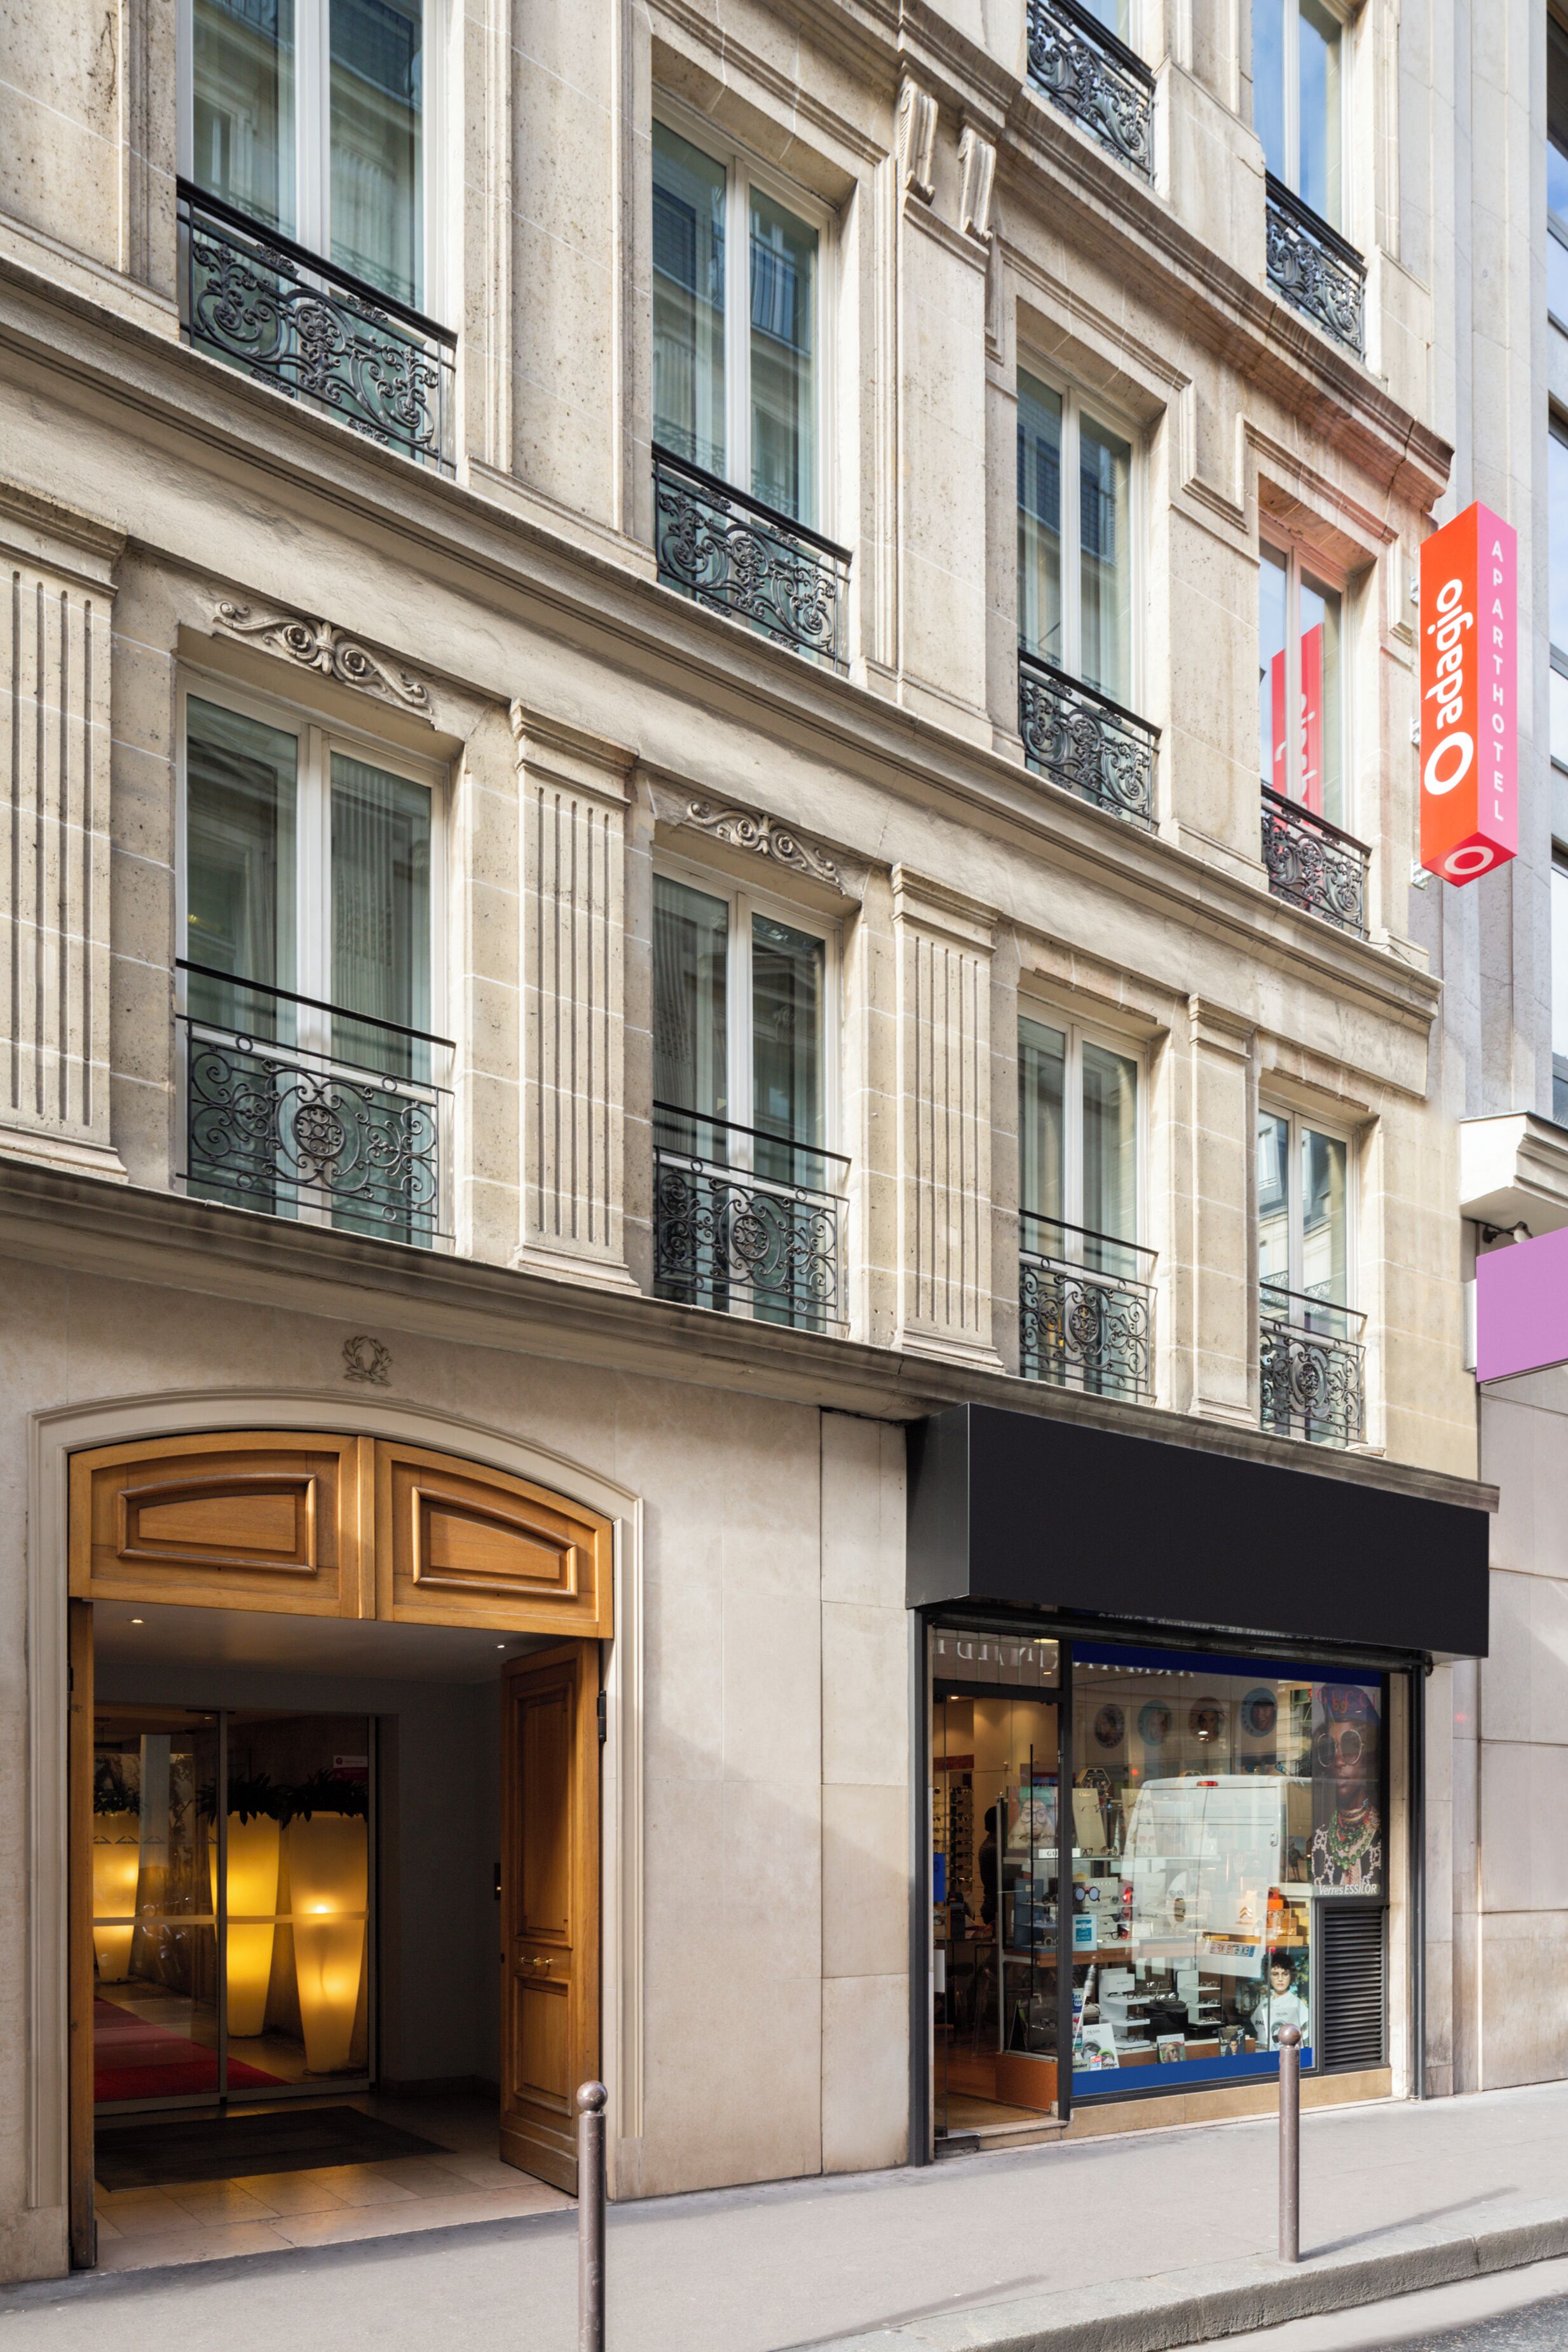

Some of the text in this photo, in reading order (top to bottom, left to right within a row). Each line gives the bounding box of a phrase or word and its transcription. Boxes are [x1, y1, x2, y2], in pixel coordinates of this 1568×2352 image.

[1424, 578, 1474, 730] adagio
[1491, 540, 1504, 822] APARTHOTEL
[1316, 1688, 1375, 1709] GUCCI
[1319, 1884, 1377, 1895] Verres ESSILOR
